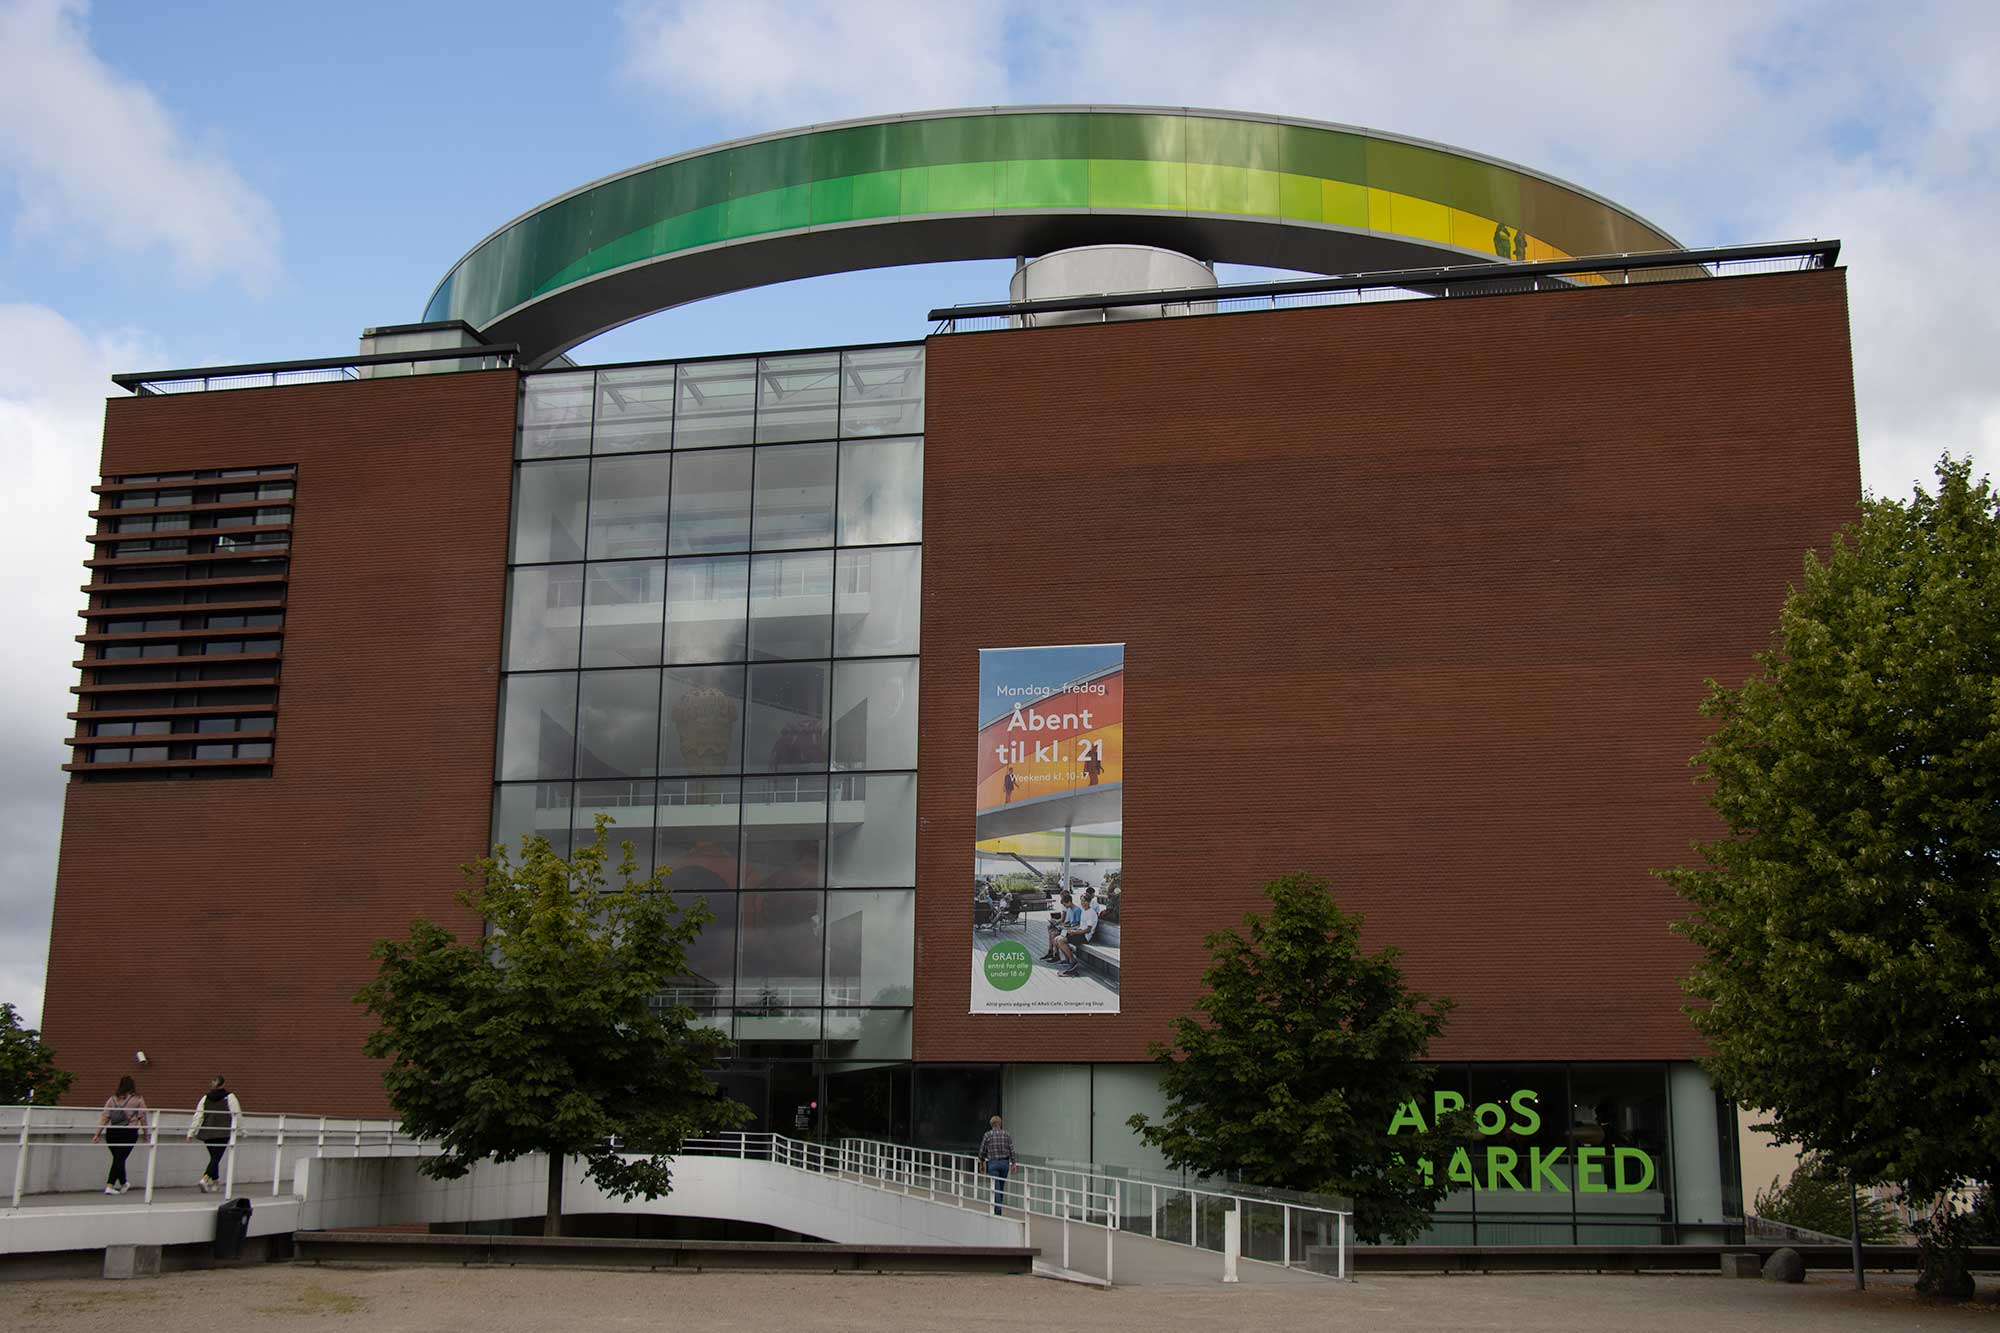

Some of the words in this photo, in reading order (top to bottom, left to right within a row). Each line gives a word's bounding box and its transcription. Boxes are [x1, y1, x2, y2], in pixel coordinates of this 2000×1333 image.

[997, 684, 1050, 697] Mandag
[1063, 682, 1106, 696] fredag
[1007, 702, 1093, 732] Åbent
[995, 741, 1025, 764] til
[1035, 740, 1069, 763] kl.
[1077, 739, 1103, 762] 21
[1010, 772, 1051, 782] Weekend
[1053, 771, 1064, 781] kl.
[992, 952, 1025, 961] GRATIS
